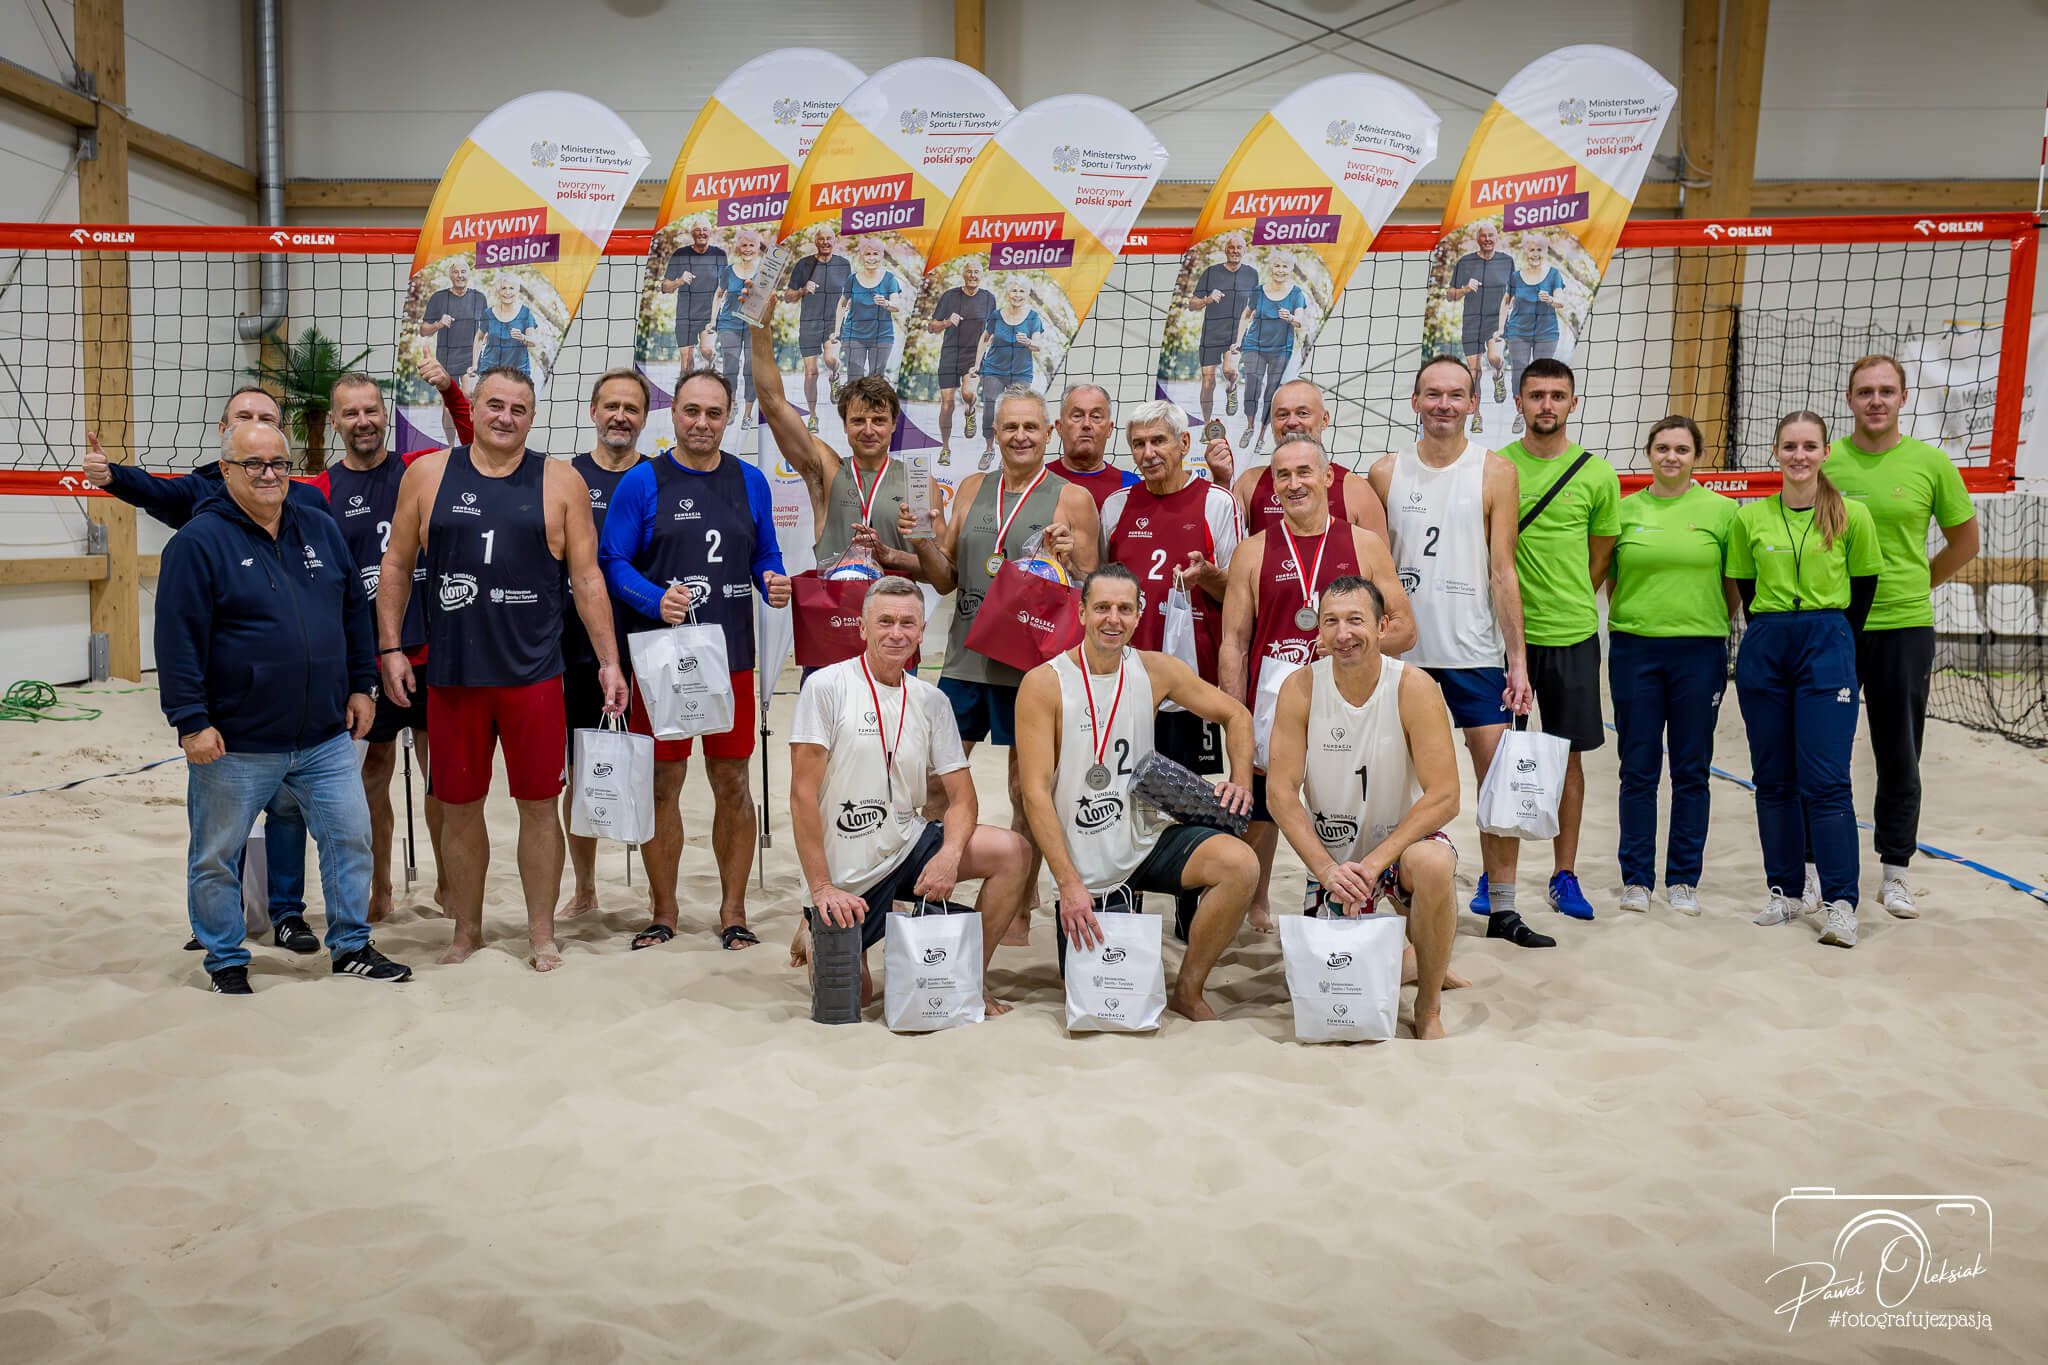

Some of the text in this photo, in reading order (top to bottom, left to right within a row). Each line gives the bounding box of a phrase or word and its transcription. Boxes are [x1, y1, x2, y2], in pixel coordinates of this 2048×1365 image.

[803, 100, 840, 110] Minister
[1589, 97, 1645, 108] Ministerstwo
[801, 110, 828, 119] Sportu
[930, 111, 986, 120] Ministerstwo
[1588, 108, 1617, 119] Sportu
[929, 120, 957, 129] Sportu
[1354, 133, 1383, 145] Sportu
[1358, 124, 1412, 141] Ministerstwo
[1587, 134, 1635, 147] tworzymy
[560, 144, 616, 156] Ministerstwo
[925, 145, 973, 156] tworzymy
[1083, 150, 1136, 161] Ministerstwo
[1586, 143, 1643, 157] polski sport
[560, 154, 587, 165] Sportu
[595, 156, 633, 167] Turystyki
[923, 155, 976, 165] polski spo
[1081, 159, 1109, 169] Sportu
[1115, 162, 1152, 171] Turystyki
[1346, 160, 1394, 177] tworzymy
[1344, 171, 1375, 184] polski
[558, 180, 606, 191] tworzymy
[692, 171, 781, 198] Aktywny
[1477, 173, 1569, 204] Aktywny
[557, 190, 615, 202] polski sport
[816, 180, 906, 207] Aktywny
[1077, 186, 1125, 197] tworzymy
[1075, 195, 1133, 208] polski sport
[1231, 193, 1324, 216] Aktywny
[851, 205, 915, 230] Senior
[1513, 198, 1579, 226] Senior
[449, 214, 540, 241] Aktywny
[966, 218, 1056, 241] Aktywny
[1263, 217, 1331, 241] Senior
[1727, 226, 1772, 237] ORLEN
[1938, 221, 1983, 233] ORLEN
[92, 232, 135, 243] ORLEN
[292, 234, 335, 245] ORLEN
[485, 239, 550, 264] Senior
[1000, 242, 1064, 266] Senior
[1704, 480, 1748, 491] ORLEN
[377, 521, 392, 553] 2
[1424, 526, 1440, 557] 2
[481, 530, 494, 564] 1
[706, 529, 723, 563] 2
[1148, 549, 1167, 580] 2
[363, 576, 379, 590] TTO
[453, 574, 477, 582] FUNDACJA
[1275, 572, 1298, 581] FUNDAC
[1401, 577, 1413, 588] TTO
[445, 585, 469, 599] LOTTO
[963, 599, 979, 611] OTTO
[1031, 616, 1055, 629] POLSKA
[1275, 650, 1300, 663] LOTTO
[1203, 719, 1213, 751] 5
[1115, 738, 1132, 776] 2
[1355, 765, 1367, 801] 1
[1094, 791, 1119, 799] FUNDACJA
[860, 798, 886, 806] FUNDACJA
[847, 810, 878, 827] LOTTO
[1083, 802, 1115, 823] LOTTO
[1320, 824, 1349, 838] LOTTO
[1332, 957, 1348, 965] LOTTO
